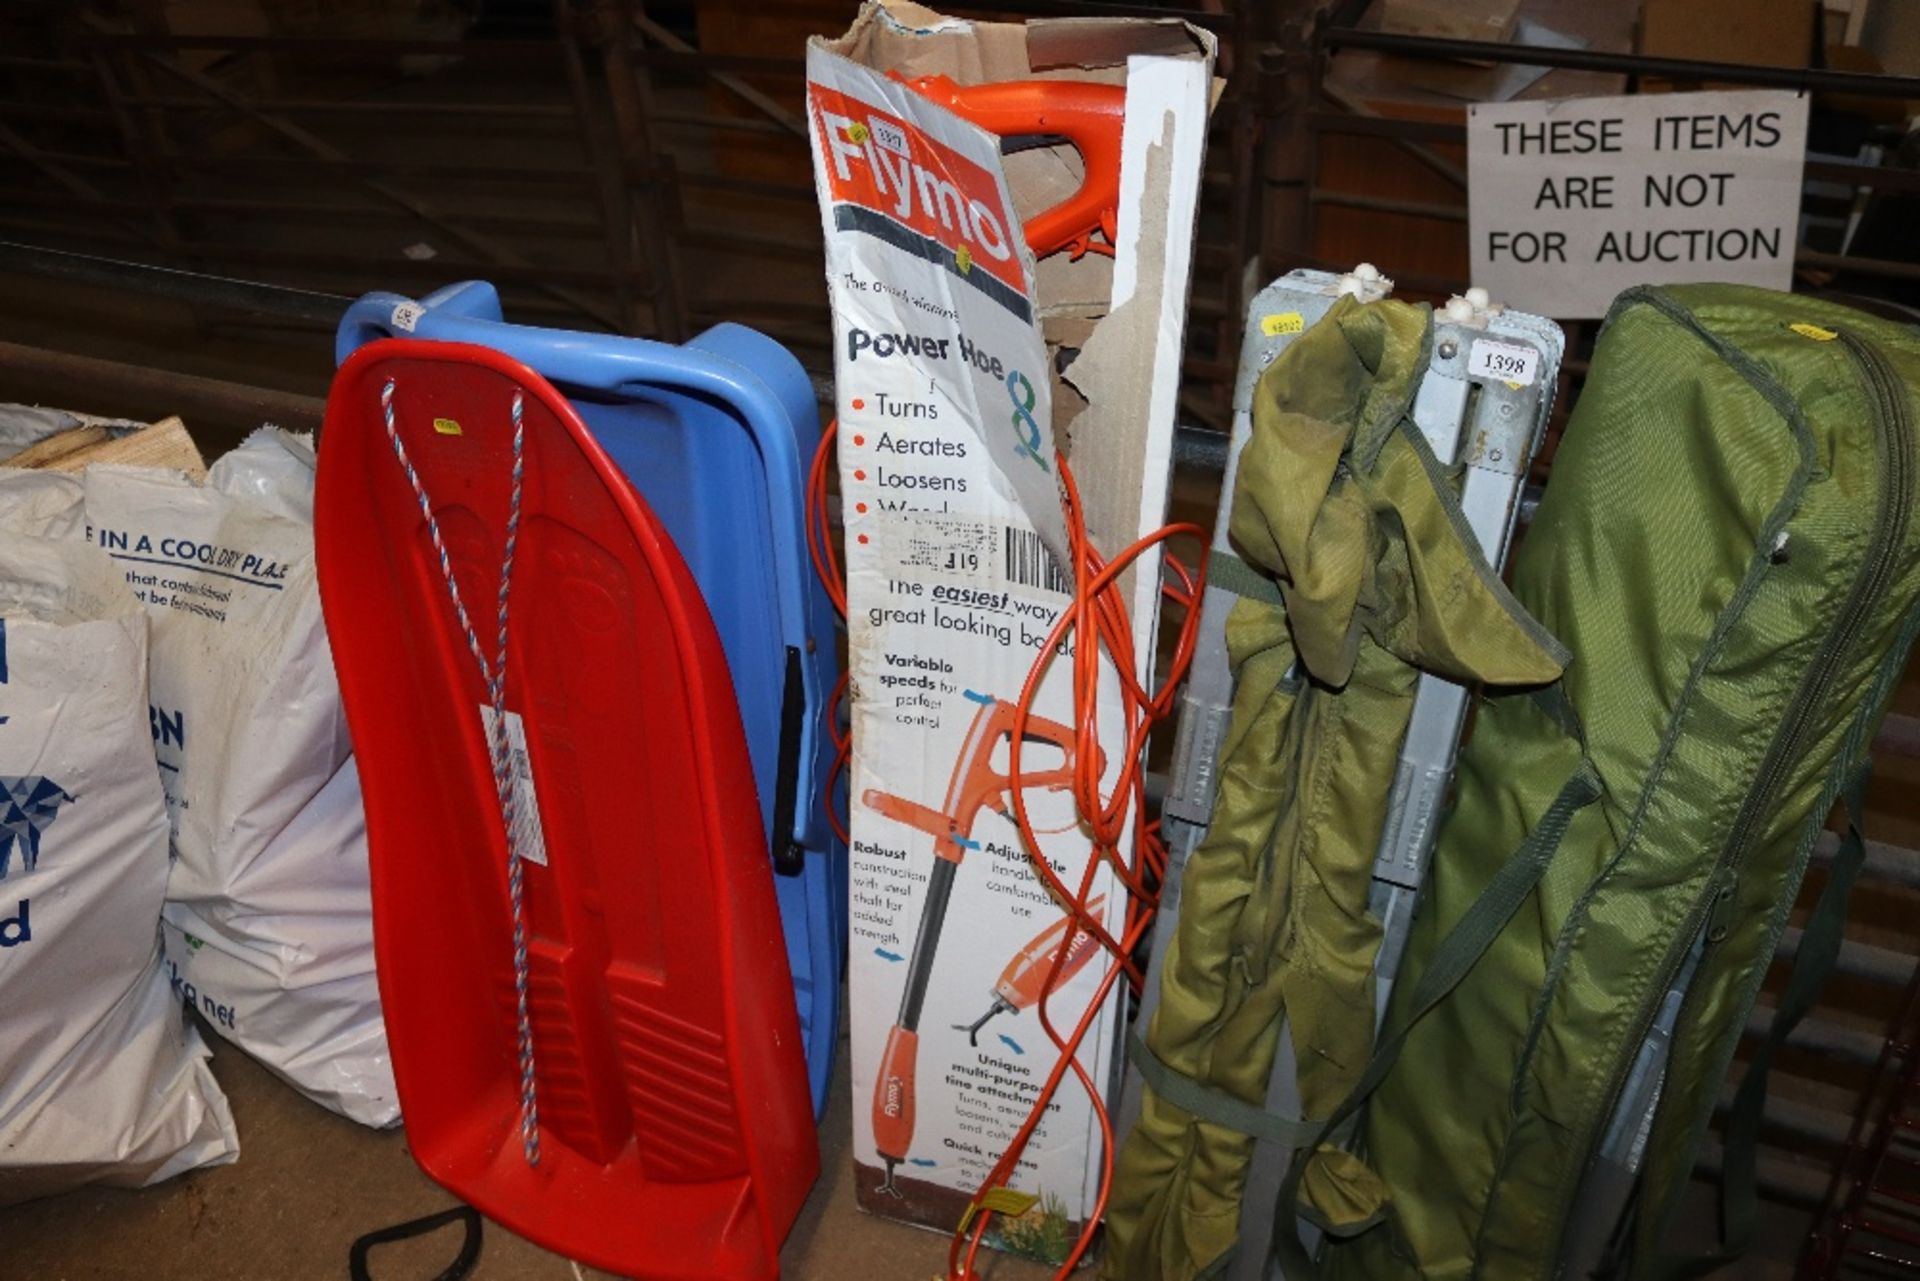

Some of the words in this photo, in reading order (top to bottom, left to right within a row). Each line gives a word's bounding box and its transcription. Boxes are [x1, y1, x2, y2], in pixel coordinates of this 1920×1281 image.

[1494, 118, 1623, 155] THESE
[1653, 112, 1782, 151] ITEMS
[823, 110, 1011, 261] Flymo
[1535, 176, 1614, 210] ARE
[1645, 173, 1735, 208] NOT
[1489, 231, 1567, 263] FOR
[1595, 228, 1781, 263] AUCTION
[957, 333, 1005, 381] Hoe
[1483, 352, 1526, 374] 1398
[876, 393, 939, 420] Turns
[876, 431, 967, 458] Aerates
[877, 466, 967, 493] Loosens
[100, 529, 128, 550] IN
[134, 535, 152, 554] A
[160, 538, 216, 565] COOL
[126, 571, 158, 586] that
[932, 583, 1009, 609] easiest
[1013, 599, 1059, 626] way
[869, 607, 926, 627] great
[934, 606, 1011, 646] looking
[885, 654, 953, 673] Variable
[880, 676, 936, 690] speeds
[853, 841, 907, 860] Robust
[203, 994, 236, 1030] net
[978, 1053, 1031, 1077] Unique
[944, 1138, 982, 1155] Quick
